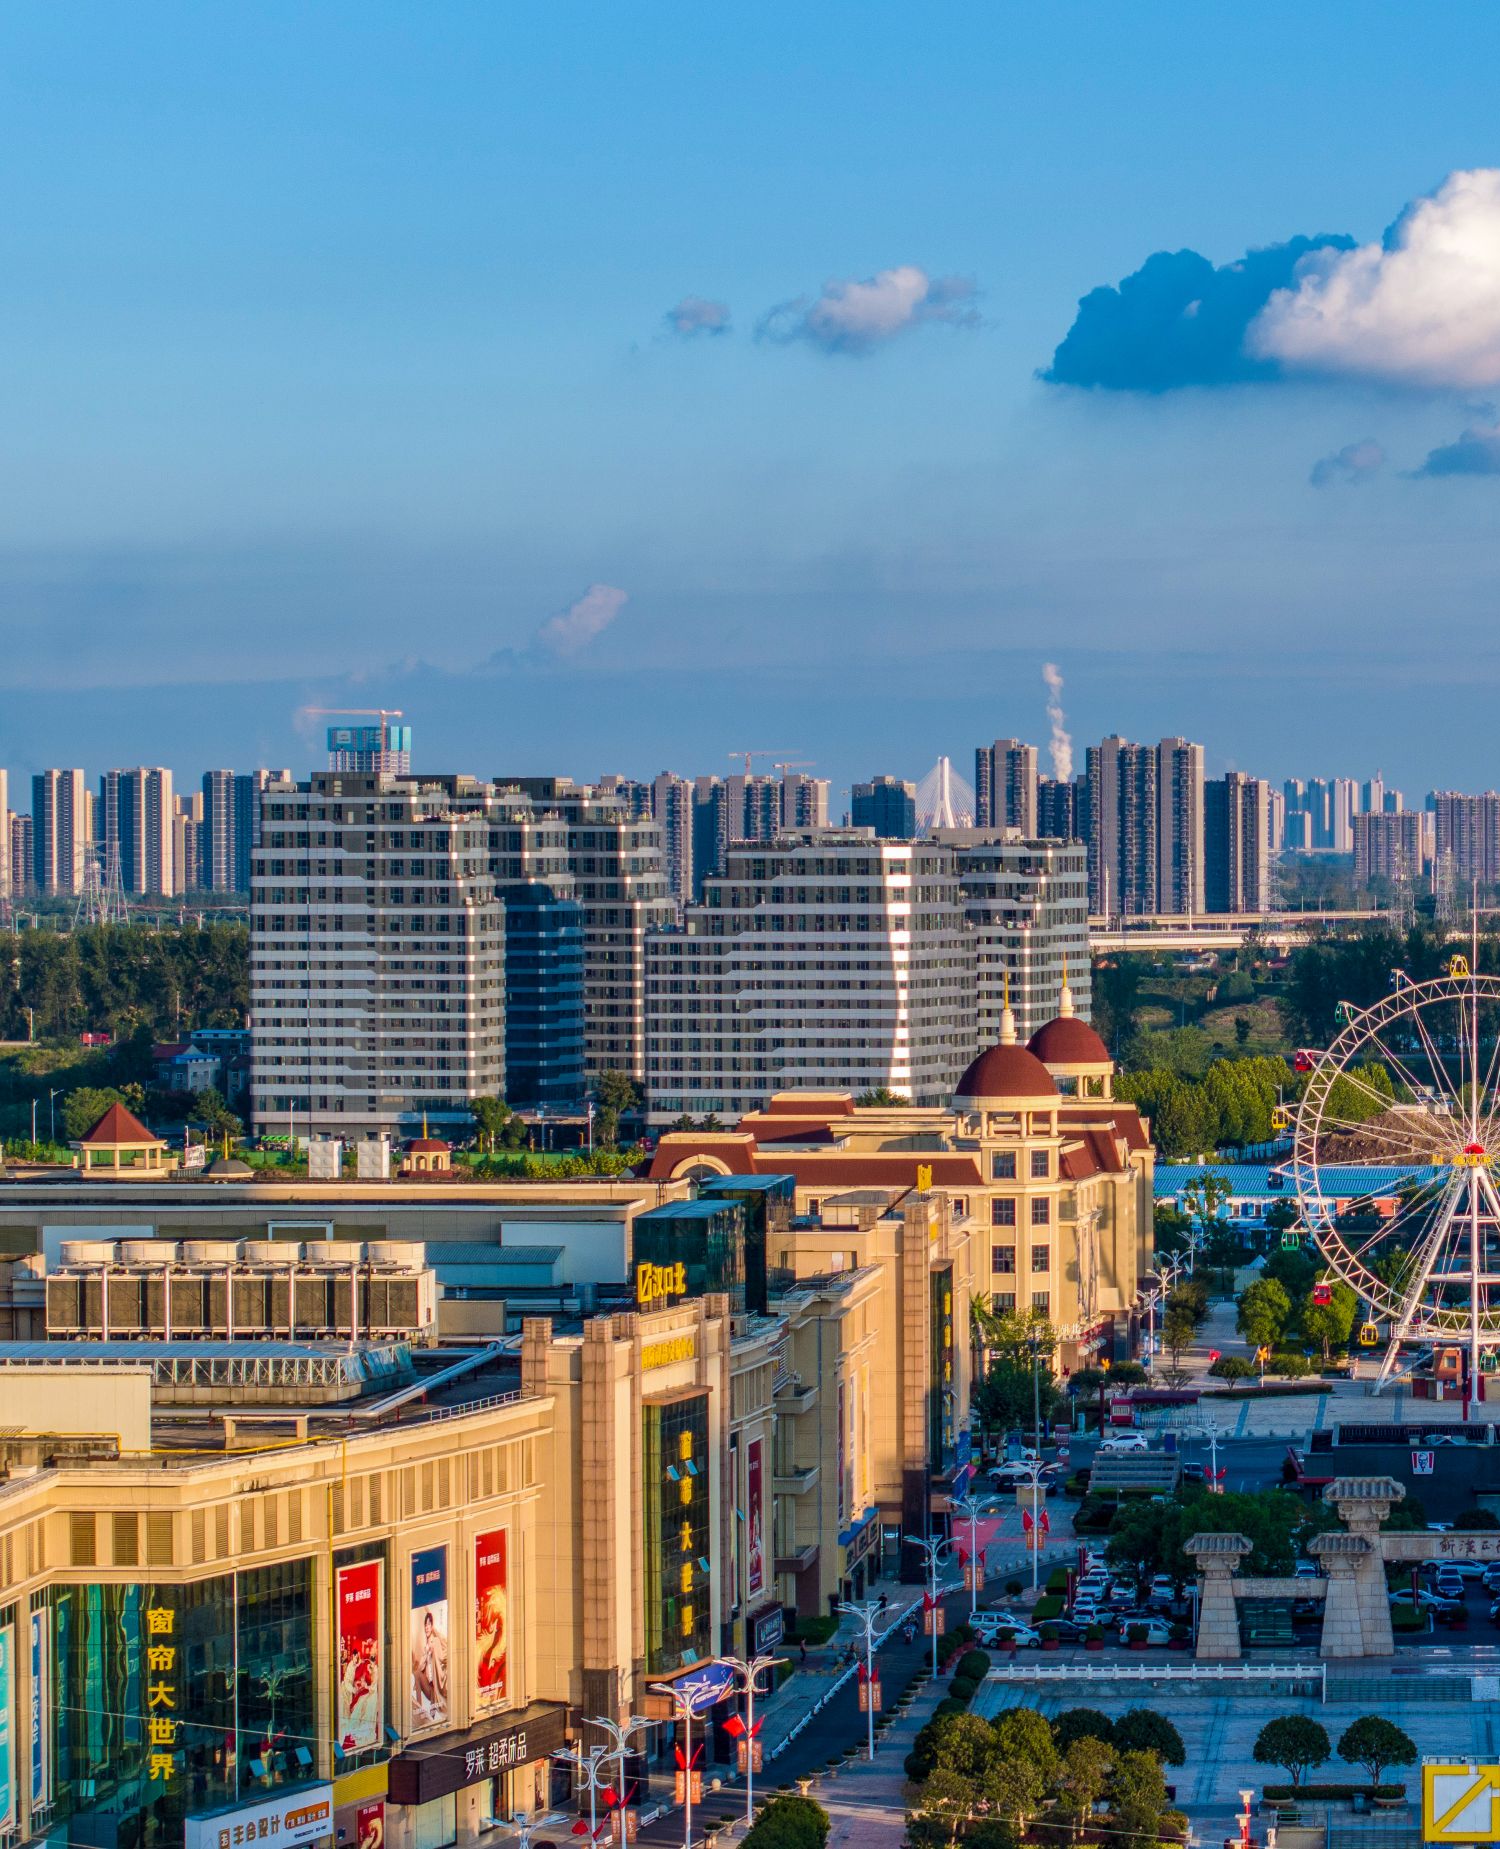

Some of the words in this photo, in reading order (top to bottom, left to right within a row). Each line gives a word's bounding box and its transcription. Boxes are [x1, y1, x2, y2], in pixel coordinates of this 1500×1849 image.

[652, 1262, 686, 1297] 汉口北
[147, 1607, 175, 1780] 窗帘大世界
[465, 1744, 485, 1779] 罗莱
[488, 1731, 527, 1771] 超柔床品
